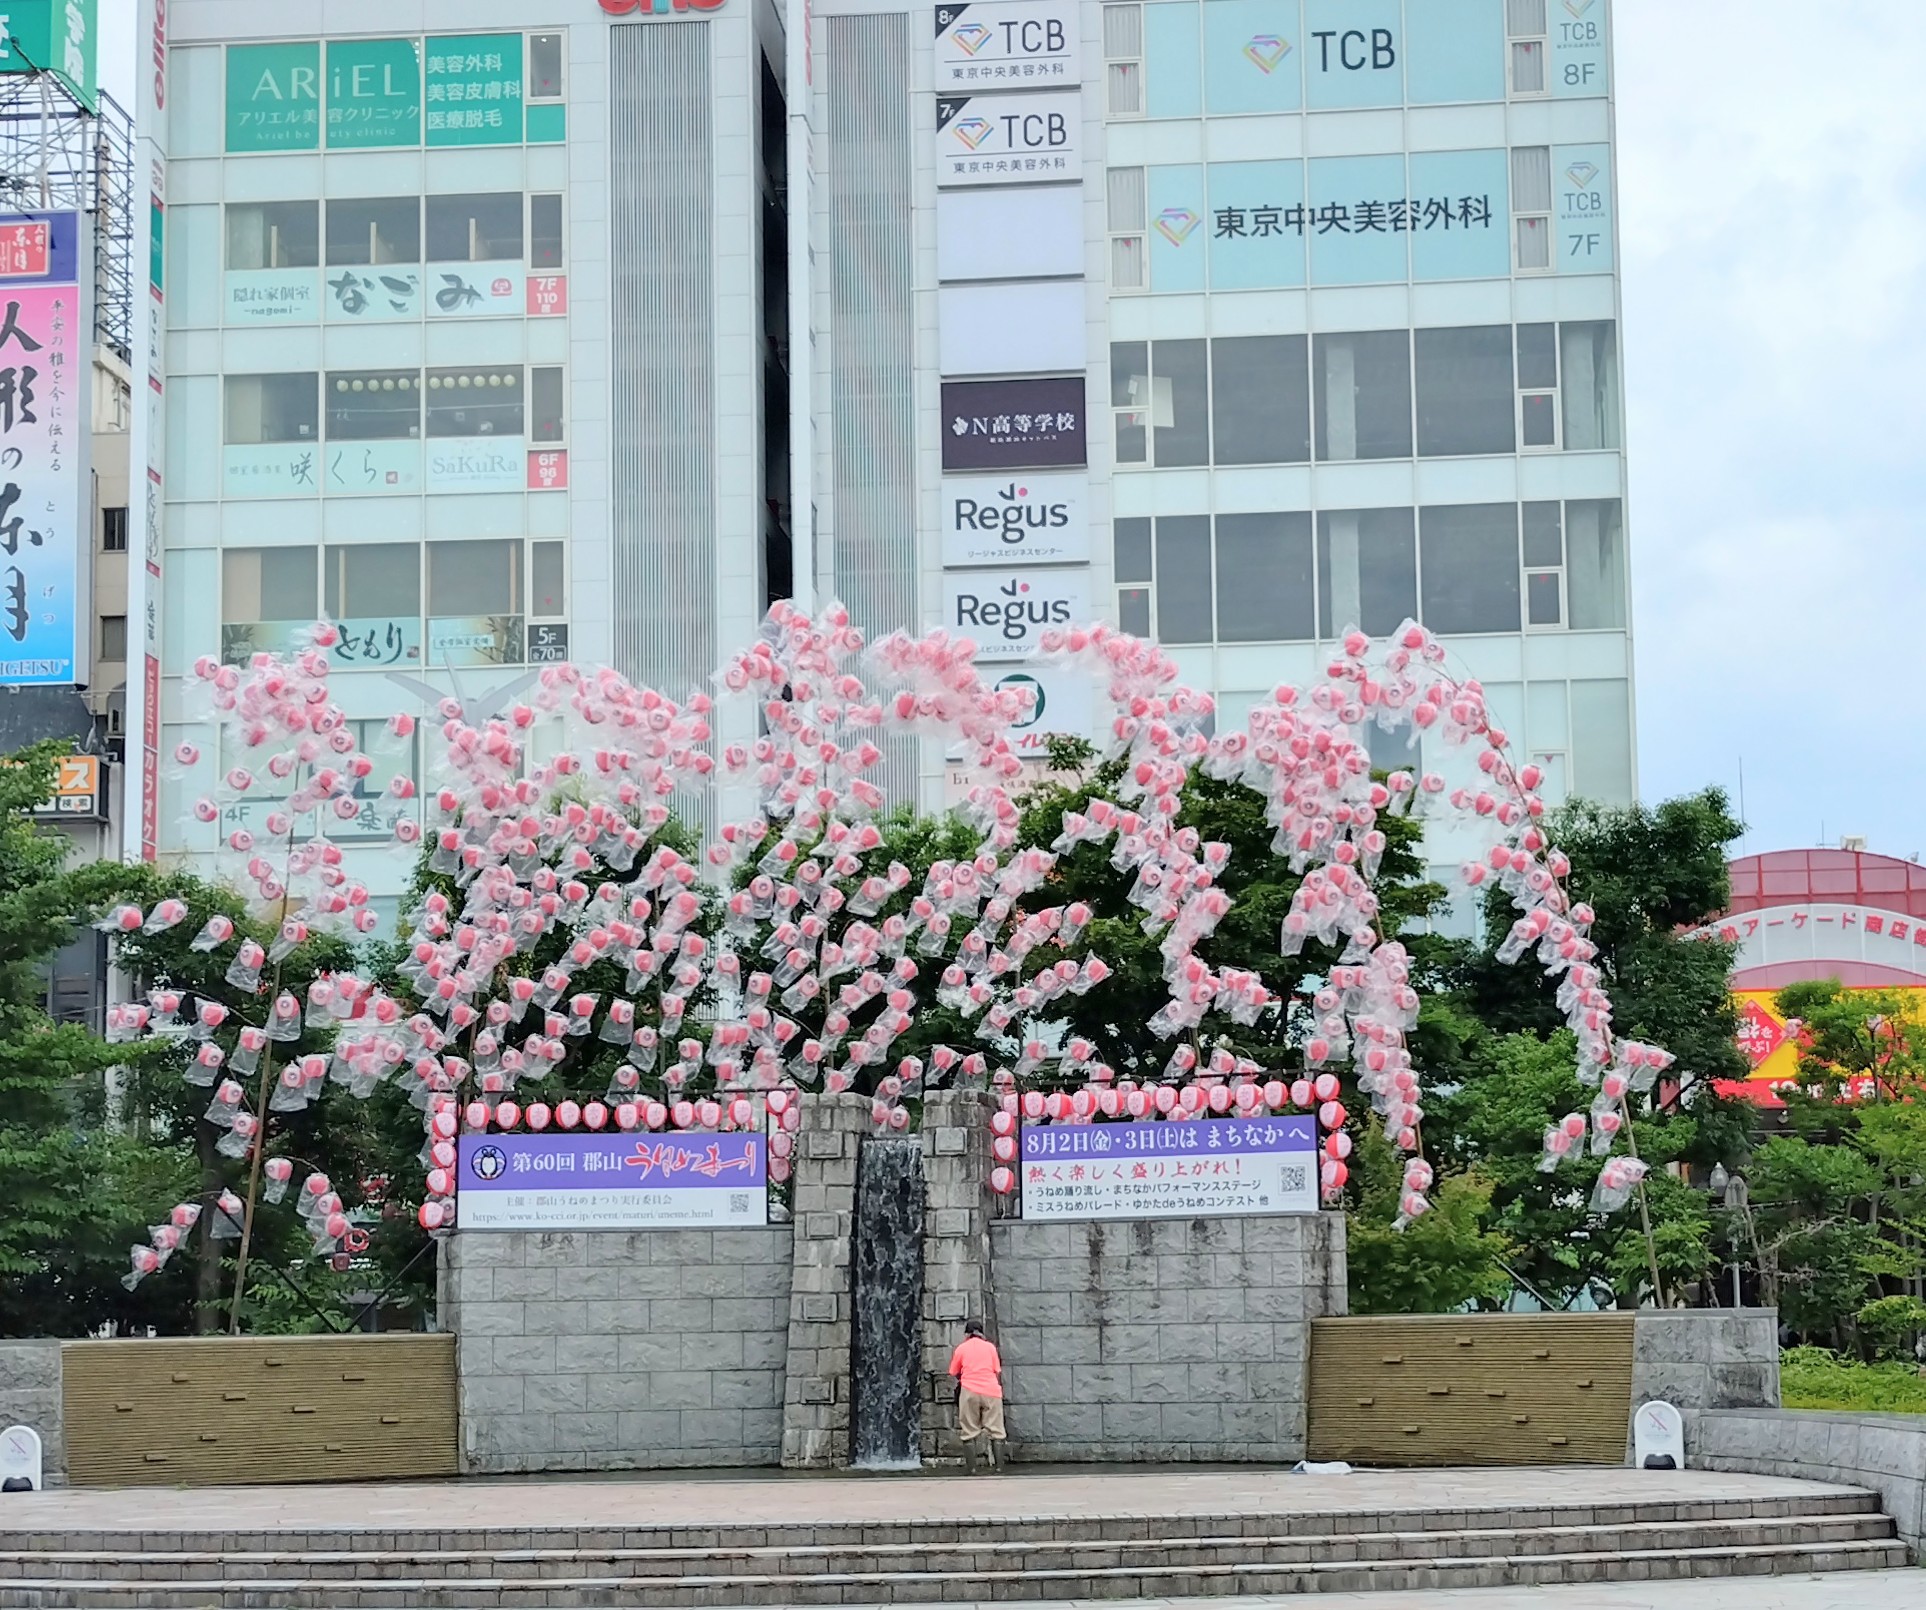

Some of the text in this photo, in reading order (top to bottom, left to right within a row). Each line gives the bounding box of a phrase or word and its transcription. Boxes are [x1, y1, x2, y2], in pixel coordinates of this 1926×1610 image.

[998, 19, 1065, 54] TCB
[1559, 22, 1598, 41] TCB
[1311, 29, 1395, 73] TCB
[427, 53, 502, 74] 美容外科
[951, 63, 1064, 80] 東京中央美容外科
[1563, 63, 1595, 86] 8F
[251, 63, 407, 101] ARiEL
[427, 80, 522, 102] 美容皮膚科
[238, 104, 420, 126] アリエル美容クリニック
[427, 109, 502, 130] 医療脱毛
[999, 113, 1067, 148] TCB
[953, 157, 1066, 174] 東京中央美容外科
[1563, 192, 1602, 211] TCB
[1212, 194, 1493, 240] 東京中央美容外科
[1568, 233, 1601, 256] 7F
[328, 271, 485, 315] なごみ
[536, 277, 557, 291] 7F
[536, 292, 558, 304] 110
[971, 412, 1075, 435] N高等学校
[538, 453, 559, 466] 6F
[954, 498, 1069, 544] Regus
[956, 594, 1071, 640] Regus
[335, 622, 402, 665] ともり
[537, 627, 557, 645] 5F
[143, 751, 154, 839] カラオケ
[225, 806, 250, 822] 4F
[512, 1151, 576, 1173] 第60回
[582, 1151, 622, 1172] 郡山
